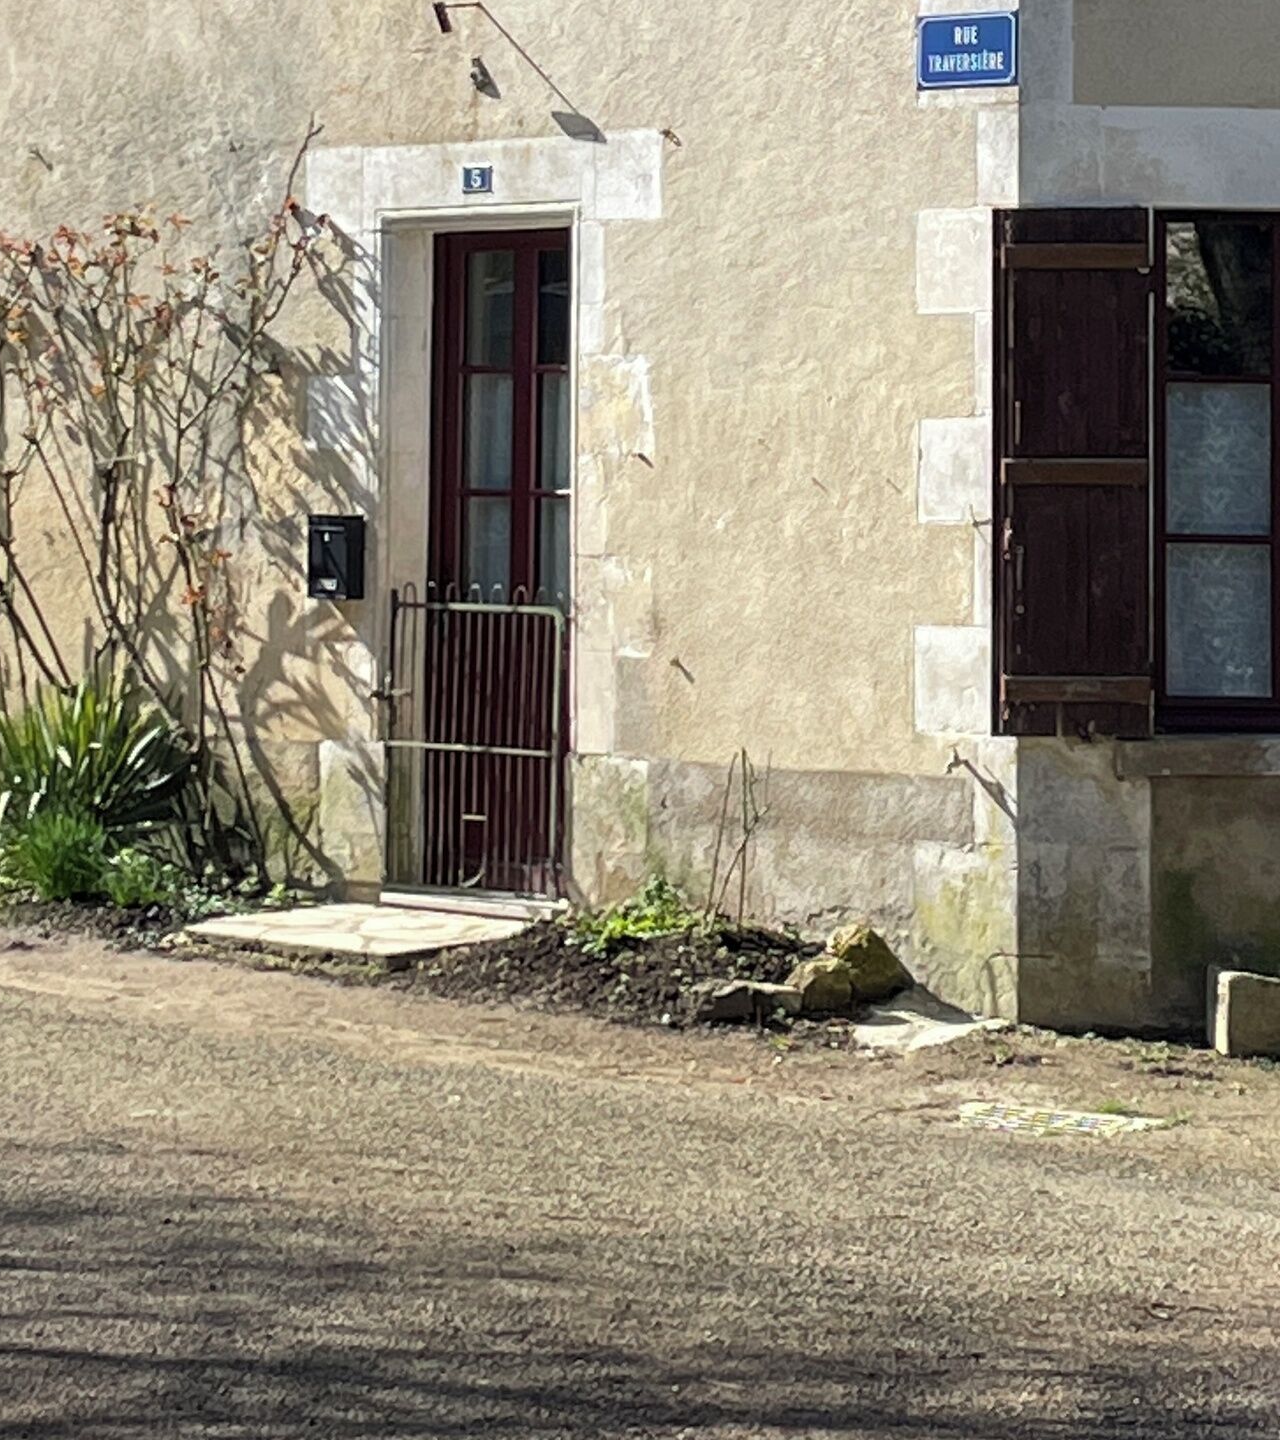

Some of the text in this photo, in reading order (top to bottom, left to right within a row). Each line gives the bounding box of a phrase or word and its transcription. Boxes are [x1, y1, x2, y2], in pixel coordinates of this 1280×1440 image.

[954, 25, 978, 45] RUE
[928, 49, 1004, 73] TRAVERSIÈRE
[471, 169, 481, 187] 5
